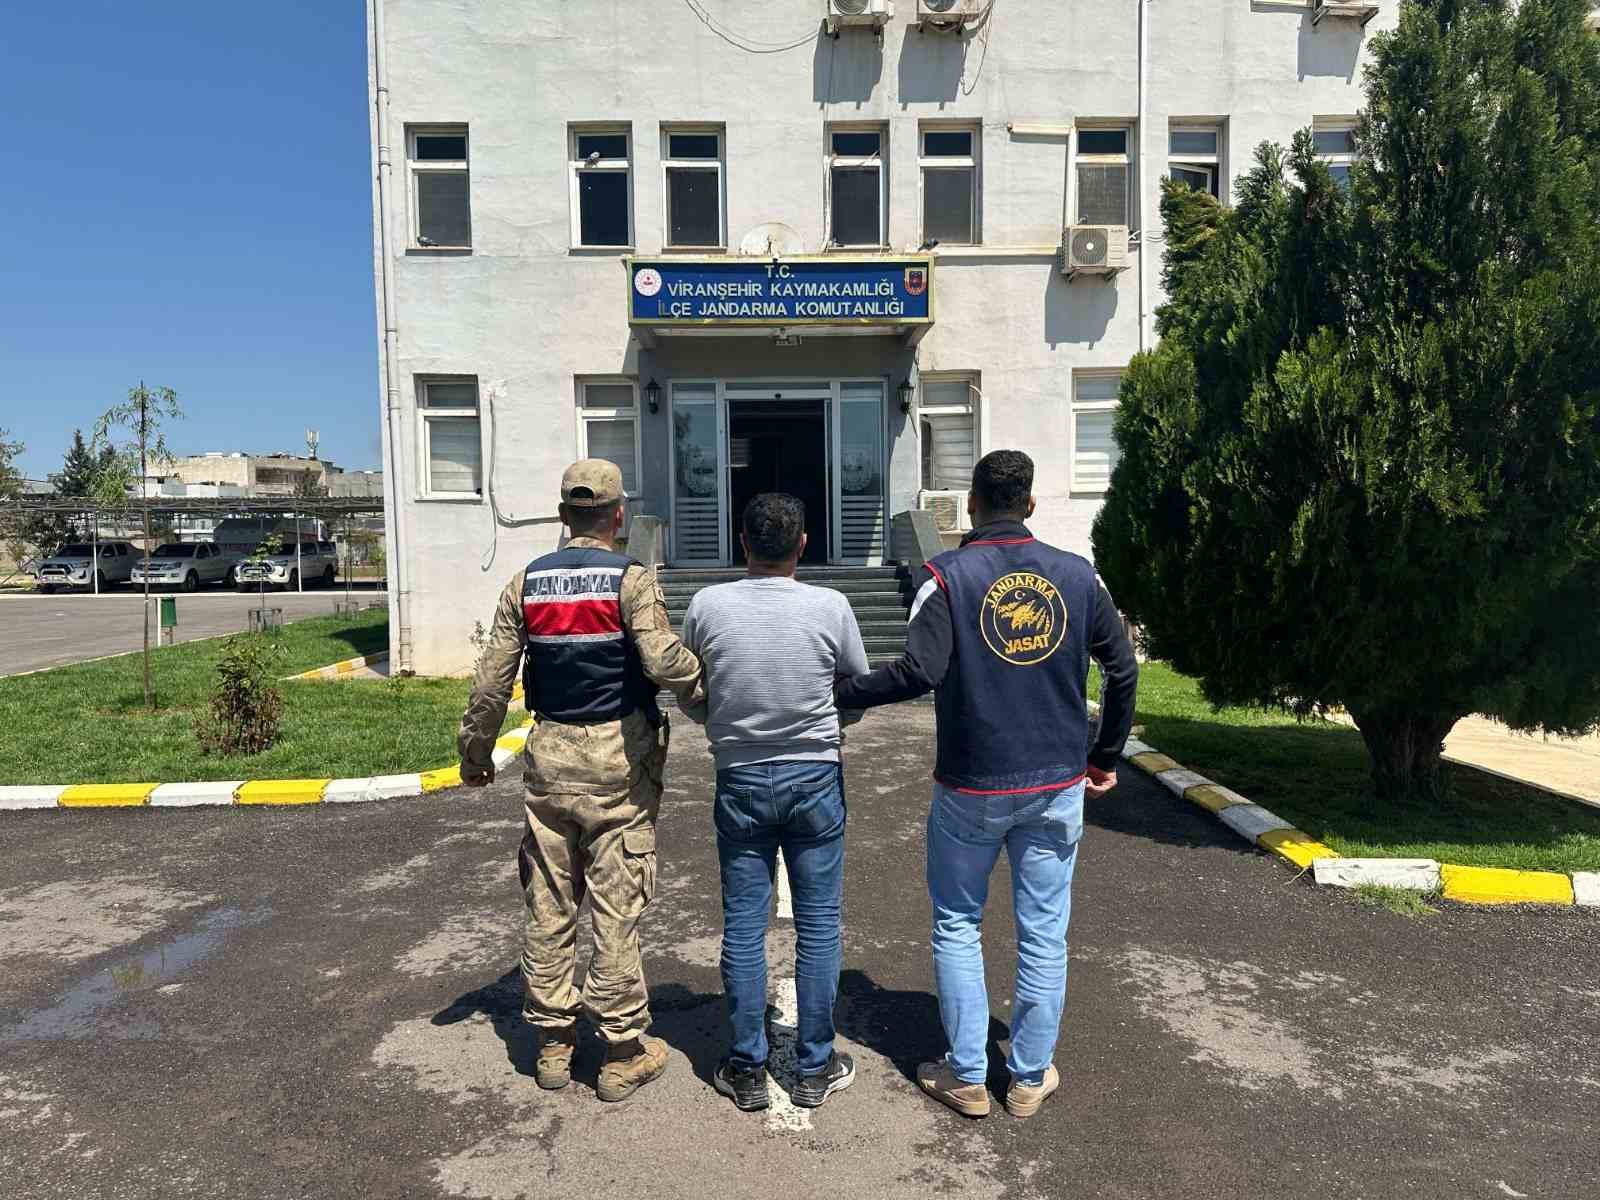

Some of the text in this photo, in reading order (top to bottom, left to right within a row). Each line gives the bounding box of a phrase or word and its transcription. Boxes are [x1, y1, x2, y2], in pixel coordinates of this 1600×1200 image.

[764, 265, 795, 278] T.C.
[667, 279, 894, 300] VİRANŞEHİR KAYMAKAMLIĞI
[658, 297, 904, 318] İLÇE JANDARMA KOMUTANLIĞI
[530, 574, 612, 595] JANDARMA
[987, 575, 1056, 609] JANDARMA
[1005, 634, 1050, 654] JASAT
